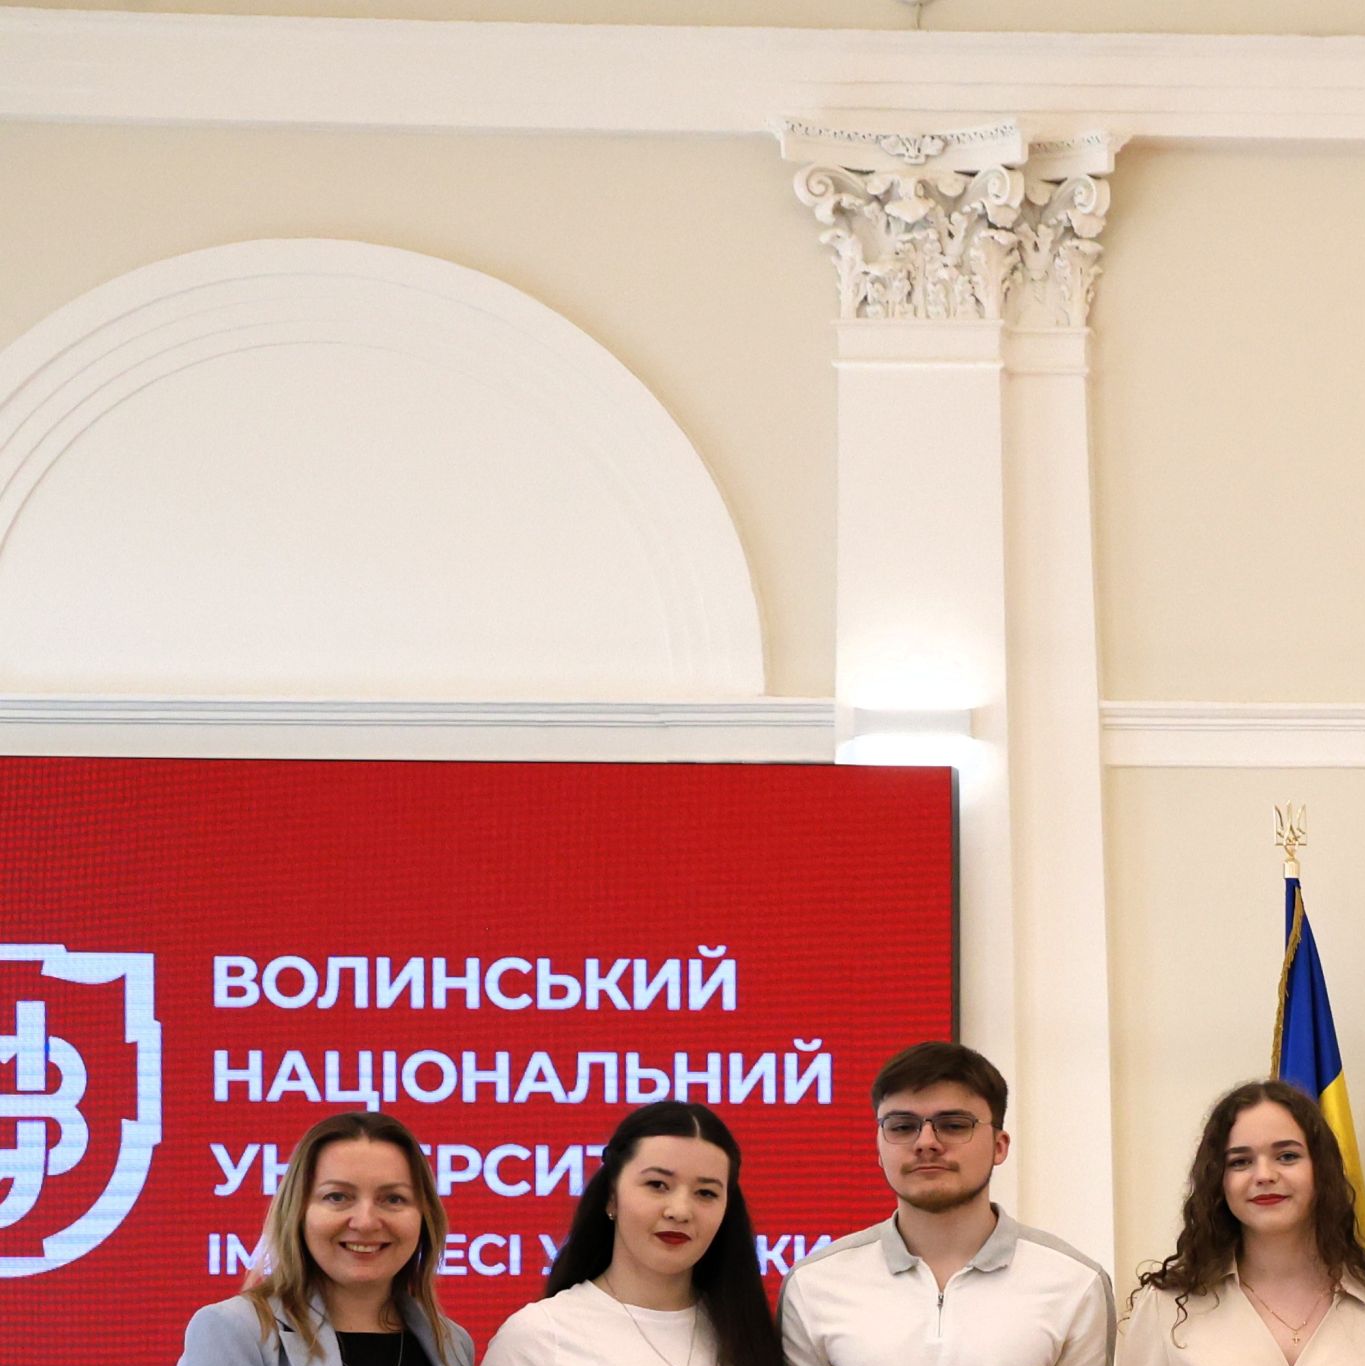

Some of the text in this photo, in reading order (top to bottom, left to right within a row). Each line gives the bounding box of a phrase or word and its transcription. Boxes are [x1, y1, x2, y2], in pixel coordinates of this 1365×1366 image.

[212, 944, 738, 1012] ВОЛИНСЬКИЙ
[212, 1037, 833, 1112] НАЦІОНАЛЬНИЙ
[438, 1233, 521, 1276] ЕСІ
